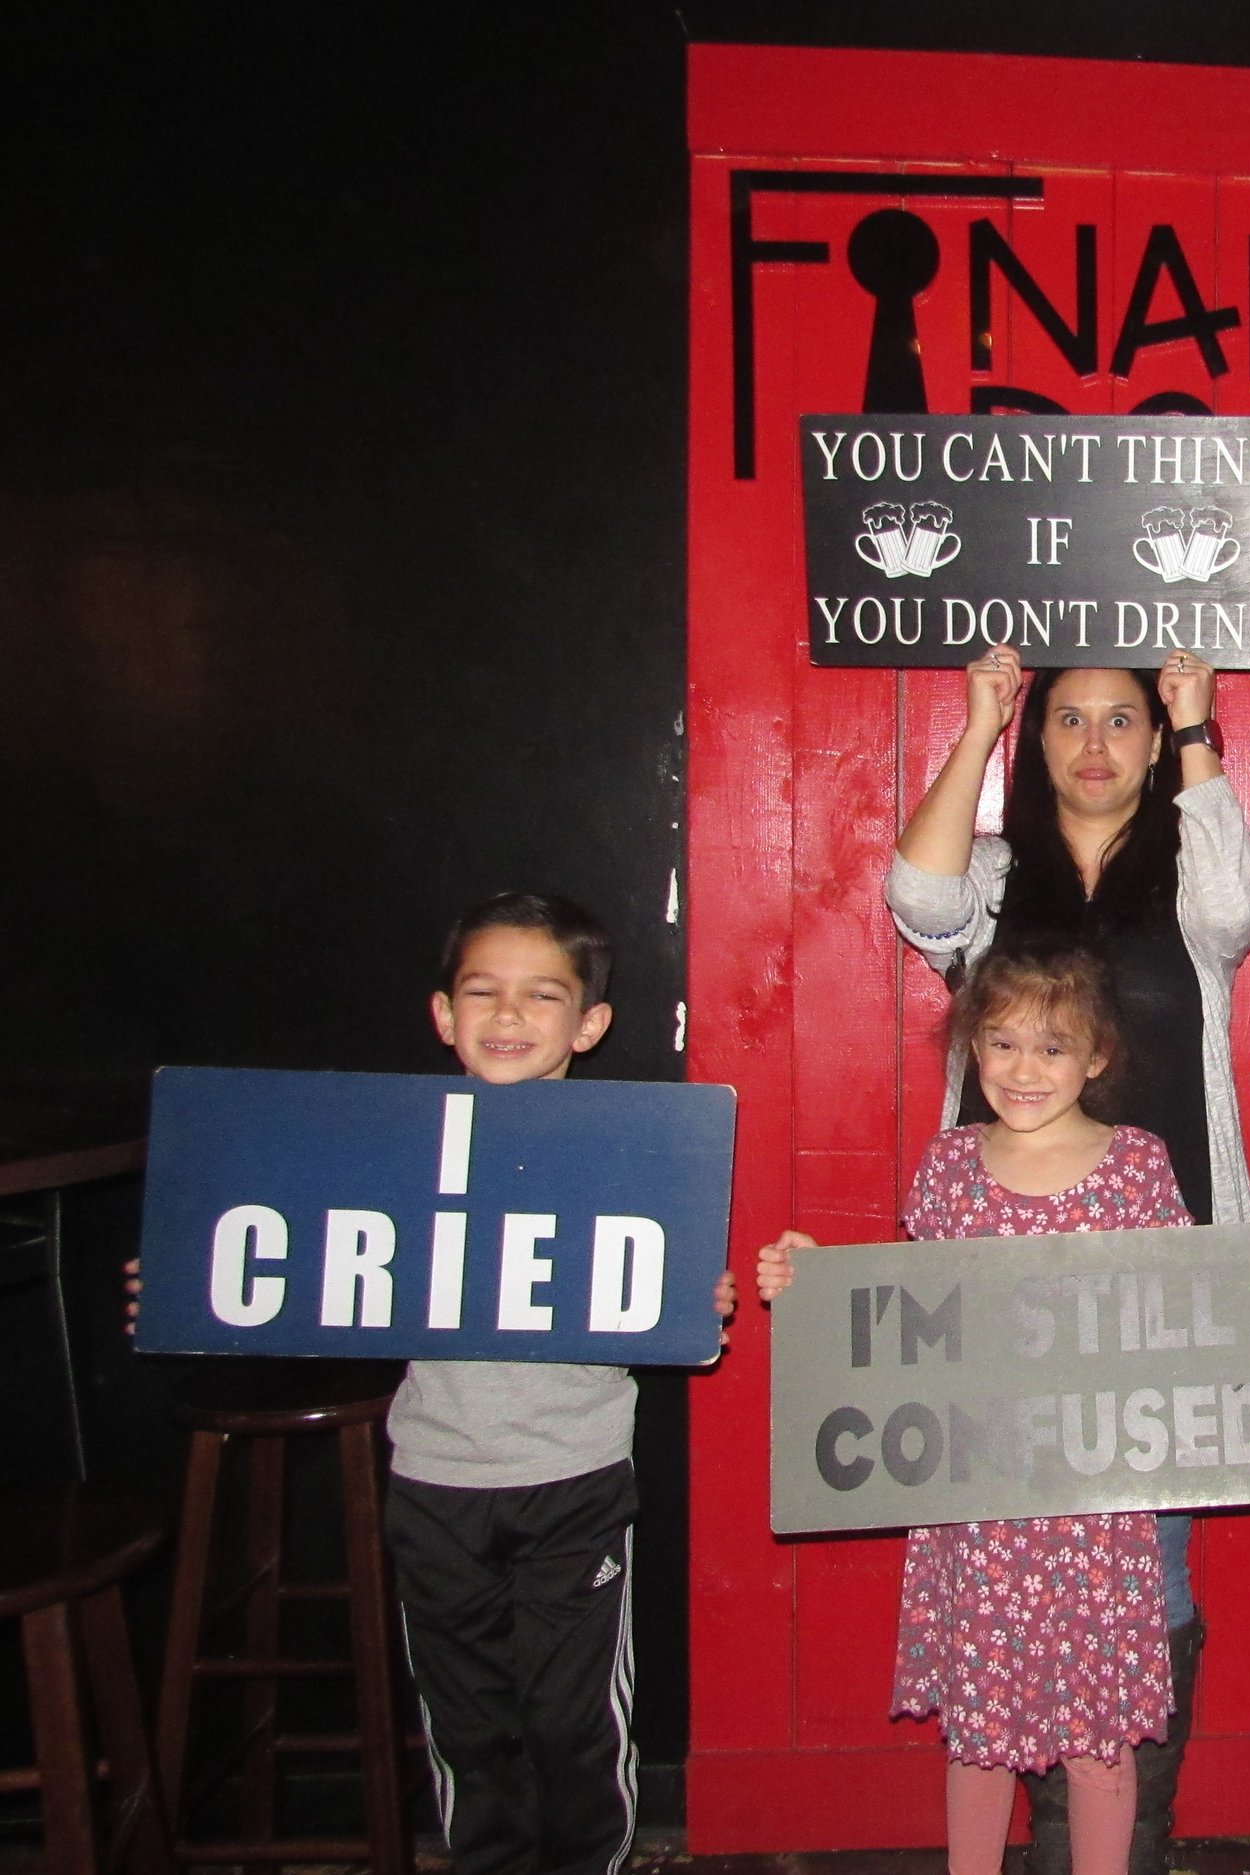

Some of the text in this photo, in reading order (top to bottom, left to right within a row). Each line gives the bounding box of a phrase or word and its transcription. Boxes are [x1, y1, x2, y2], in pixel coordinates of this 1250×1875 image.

[811, 431, 926, 482] YOU
[943, 433, 1100, 483] CAN'T
[1027, 517, 1073, 565] IF
[814, 597, 925, 645] YOU
[942, 599, 1098, 648] DON'T
[438, 1093, 475, 1195] I
[210, 1204, 667, 1333] CRIED
[850, 1272, 1237, 1368] I'M STILL
